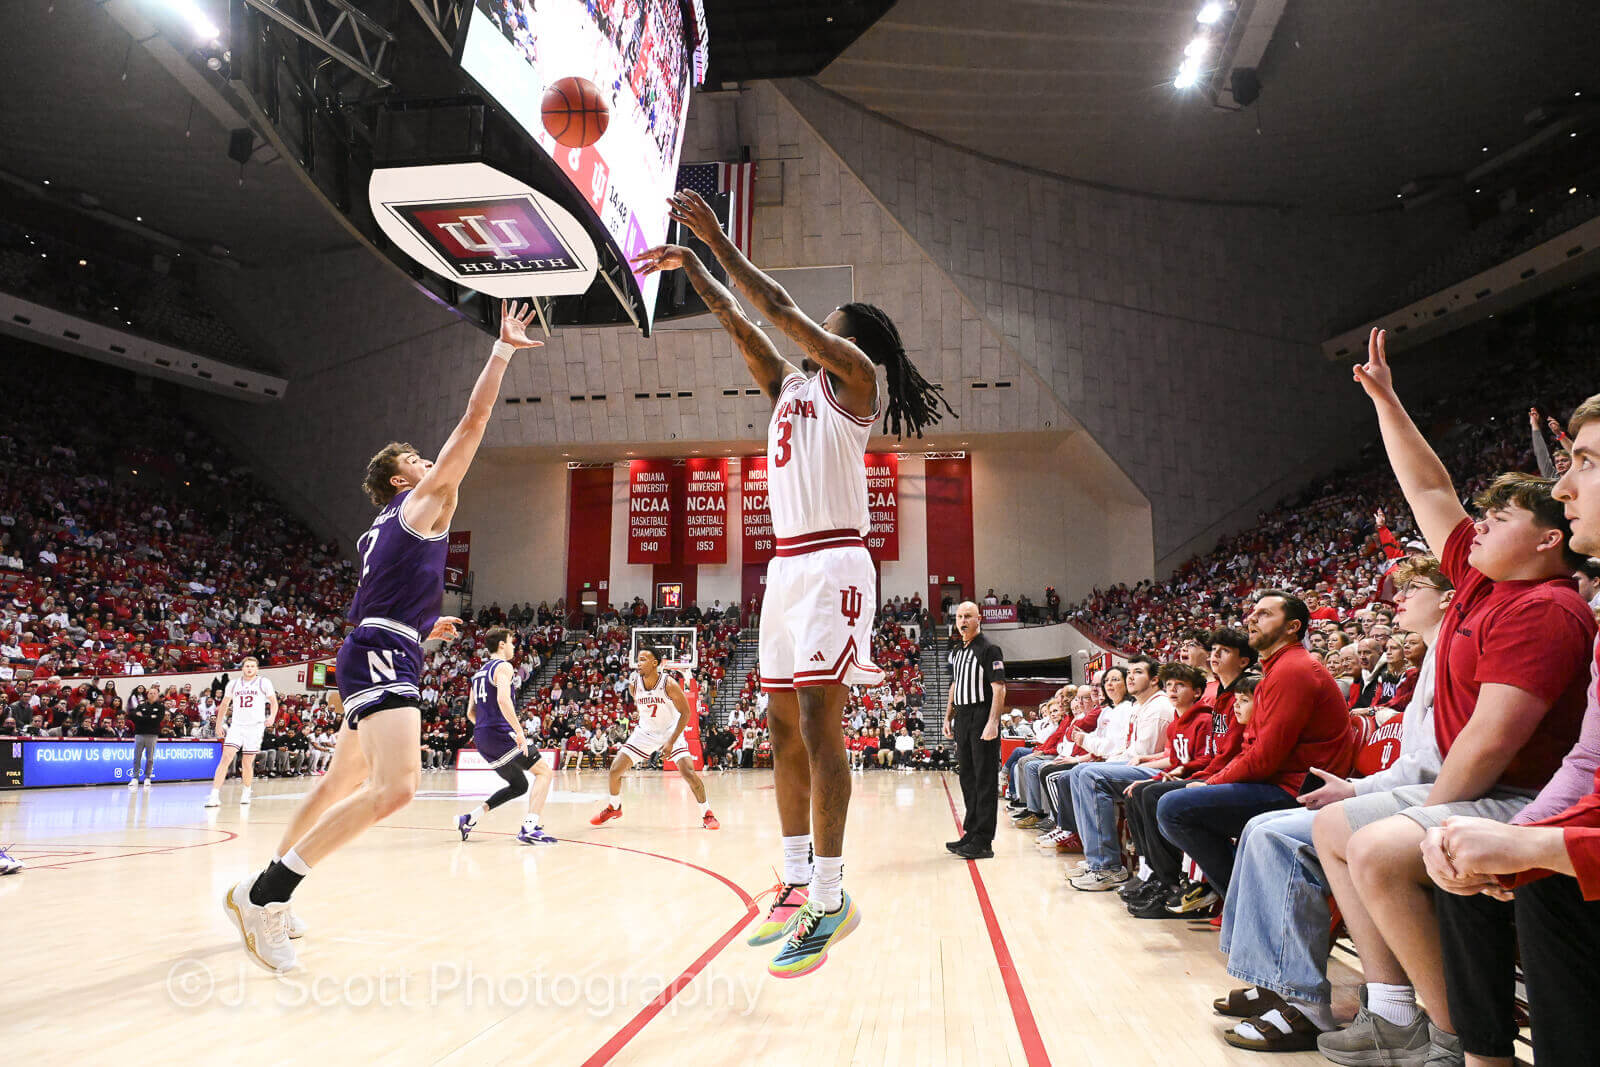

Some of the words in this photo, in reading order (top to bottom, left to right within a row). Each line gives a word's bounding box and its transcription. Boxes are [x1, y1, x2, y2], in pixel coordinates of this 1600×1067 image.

[437, 214, 531, 260] IU
[459, 258, 569, 273] HEALTH
[775, 420, 793, 468] 3
[637, 472, 665, 482] INDIANA
[692, 470, 721, 481] INDIANA
[748, 469, 768, 480] INDIA
[632, 483, 669, 493] UNIVERSITY
[688, 481, 725, 492] UNIVERSITY
[744, 481, 768, 491] UNIVER
[867, 478, 895, 488] VERSITY
[631, 497, 670, 512] NCAA
[686, 496, 726, 511] NCAA
[743, 495, 770, 511] NCA
[867, 492, 896, 507] CAA
[631, 516, 668, 526] BASKETBALL
[687, 515, 725, 525] BASKETBALL
[743, 514, 772, 525] BASKETB
[869, 511, 896, 521] KETBALL
[632, 527, 667, 537] CHAMPIONS
[688, 526, 723, 537] CHAMPIONS
[745, 526, 775, 536] CHAMPIO
[870, 523, 895, 533] MPIONS
[640, 541, 659, 551] 1940
[696, 540, 714, 551] 1953
[754, 540, 772, 550] 1976
[868, 537, 886, 548] 1987
[839, 585, 863, 627] IU
[983, 608, 1013, 617] INDIANA
[473, 676, 488, 705] 14
[240, 695, 254, 708] 12
[638, 696, 666, 705] INDIANA
[646, 703, 658, 718] 7
[1367, 722, 1404, 747] INDIAN
[36, 748, 82, 762] FOLLOW
[85, 748, 99, 761] US
[102, 747, 214, 761] @YOUALFORDSTORE
[1381, 741, 1394, 769] IU
